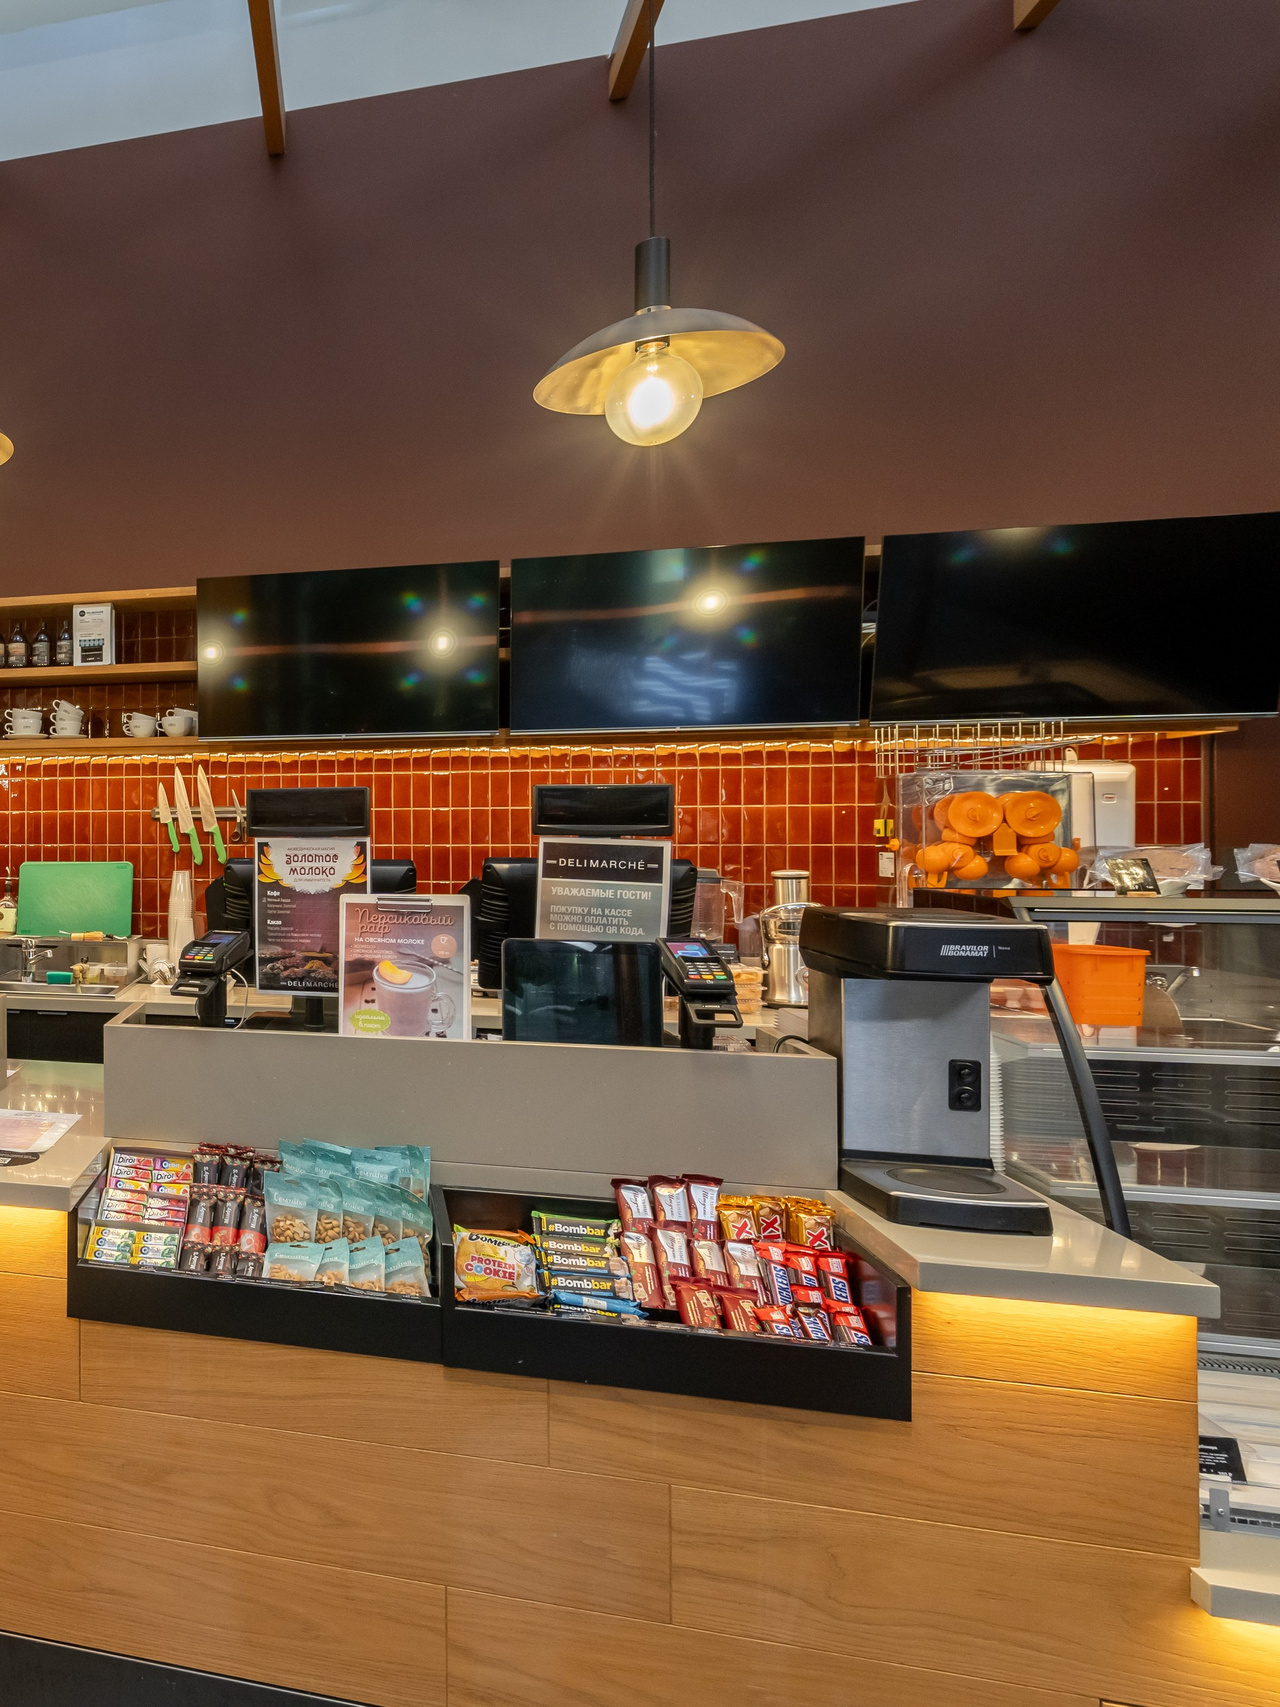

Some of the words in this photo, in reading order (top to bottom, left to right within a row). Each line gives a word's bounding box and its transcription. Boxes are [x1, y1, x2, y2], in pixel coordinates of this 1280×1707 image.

[559, 858, 645, 870] DELIMARCHÉ
[551, 887, 615, 899] УВАЖАЕМЫЕ
[617, 890, 652, 900] ГОСТИ!
[550, 905, 589, 915] ПОКУПКУ
[590, 907, 602, 915] НА
[604, 908, 632, 917] КАССЕ
[550, 914, 582, 923] МОЖНО
[585, 915, 628, 925] ОПЛАТИТЬ
[359, 922, 391, 938] раф
[557, 923, 604, 933] ПОМОЩЬЮ
[606, 925, 618, 934] QR
[620, 926, 646, 936] КОДА.
[117, 1156, 136, 1164] Dirol
[115, 1168, 134, 1176] Dirol
[156, 1172, 174, 1181] Dirol
[548, 1223, 606, 1236] #Bombbar
[542, 1240, 601, 1253] #Bombbar
[470, 1254, 516, 1271] PROTEIN
[546, 1255, 607, 1268] #Bombbar
[464, 1262, 516, 1281] COOKIE
[551, 1277, 613, 1290] #Bombbar
